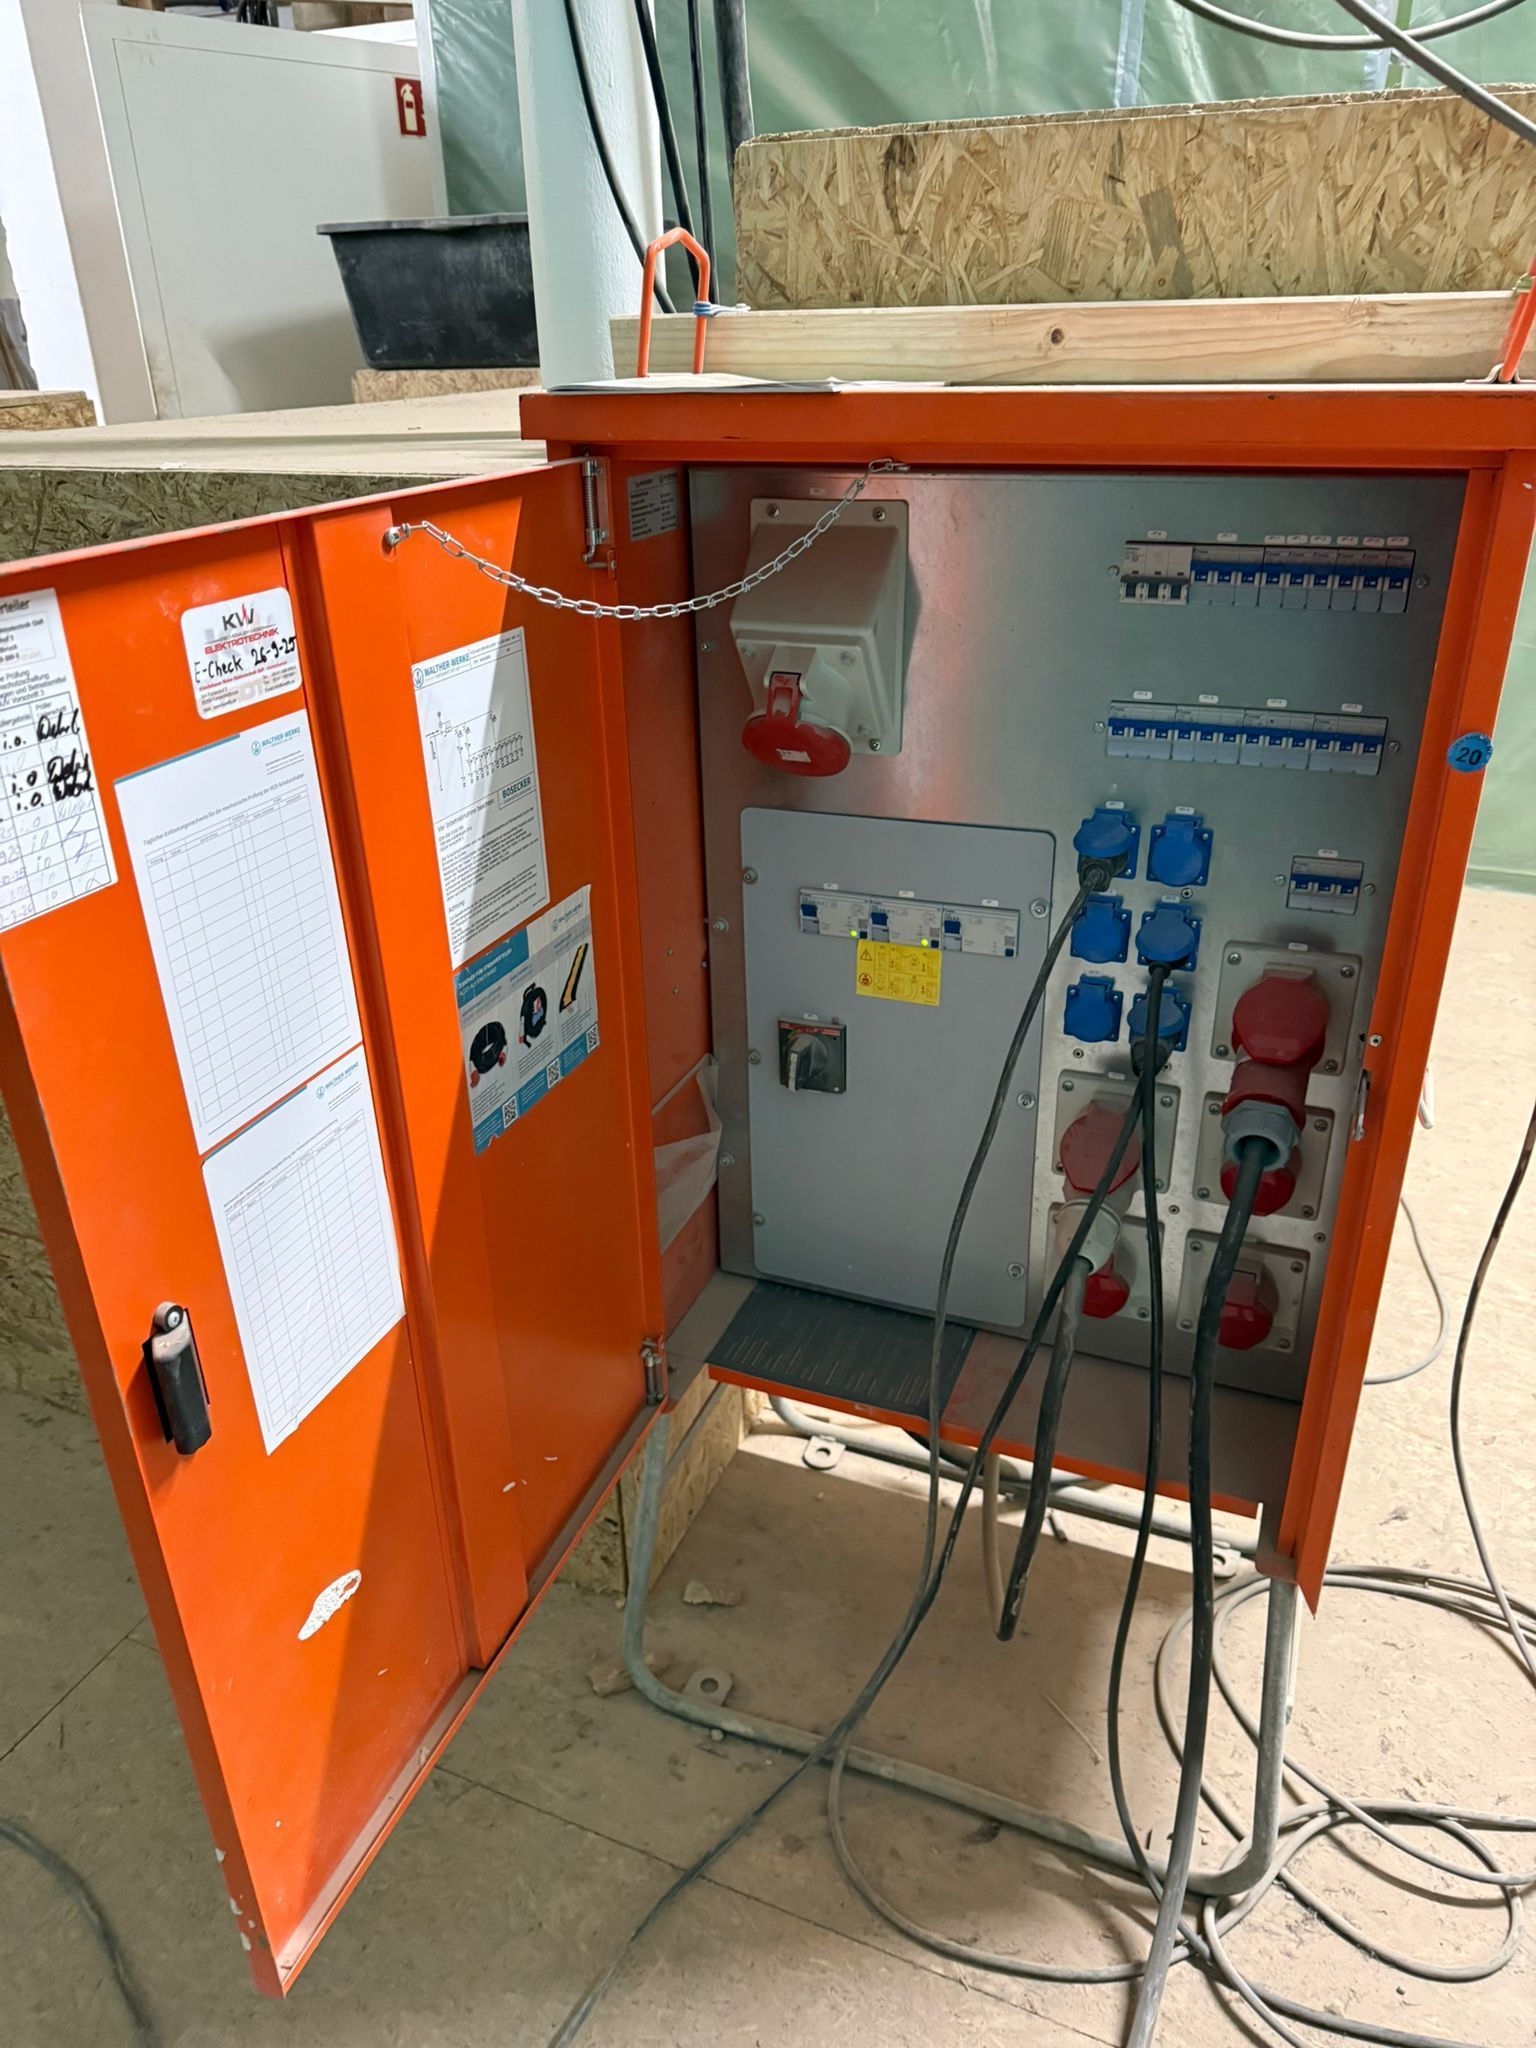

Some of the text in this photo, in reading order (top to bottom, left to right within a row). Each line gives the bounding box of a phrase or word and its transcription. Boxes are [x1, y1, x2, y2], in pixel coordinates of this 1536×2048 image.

[204, 627, 279, 655] ELEKTROTECHNIK
[194, 654, 243, 684] E-Check
[250, 636, 297, 666] 26-9-25
[1456, 747, 1483, 766] 20
